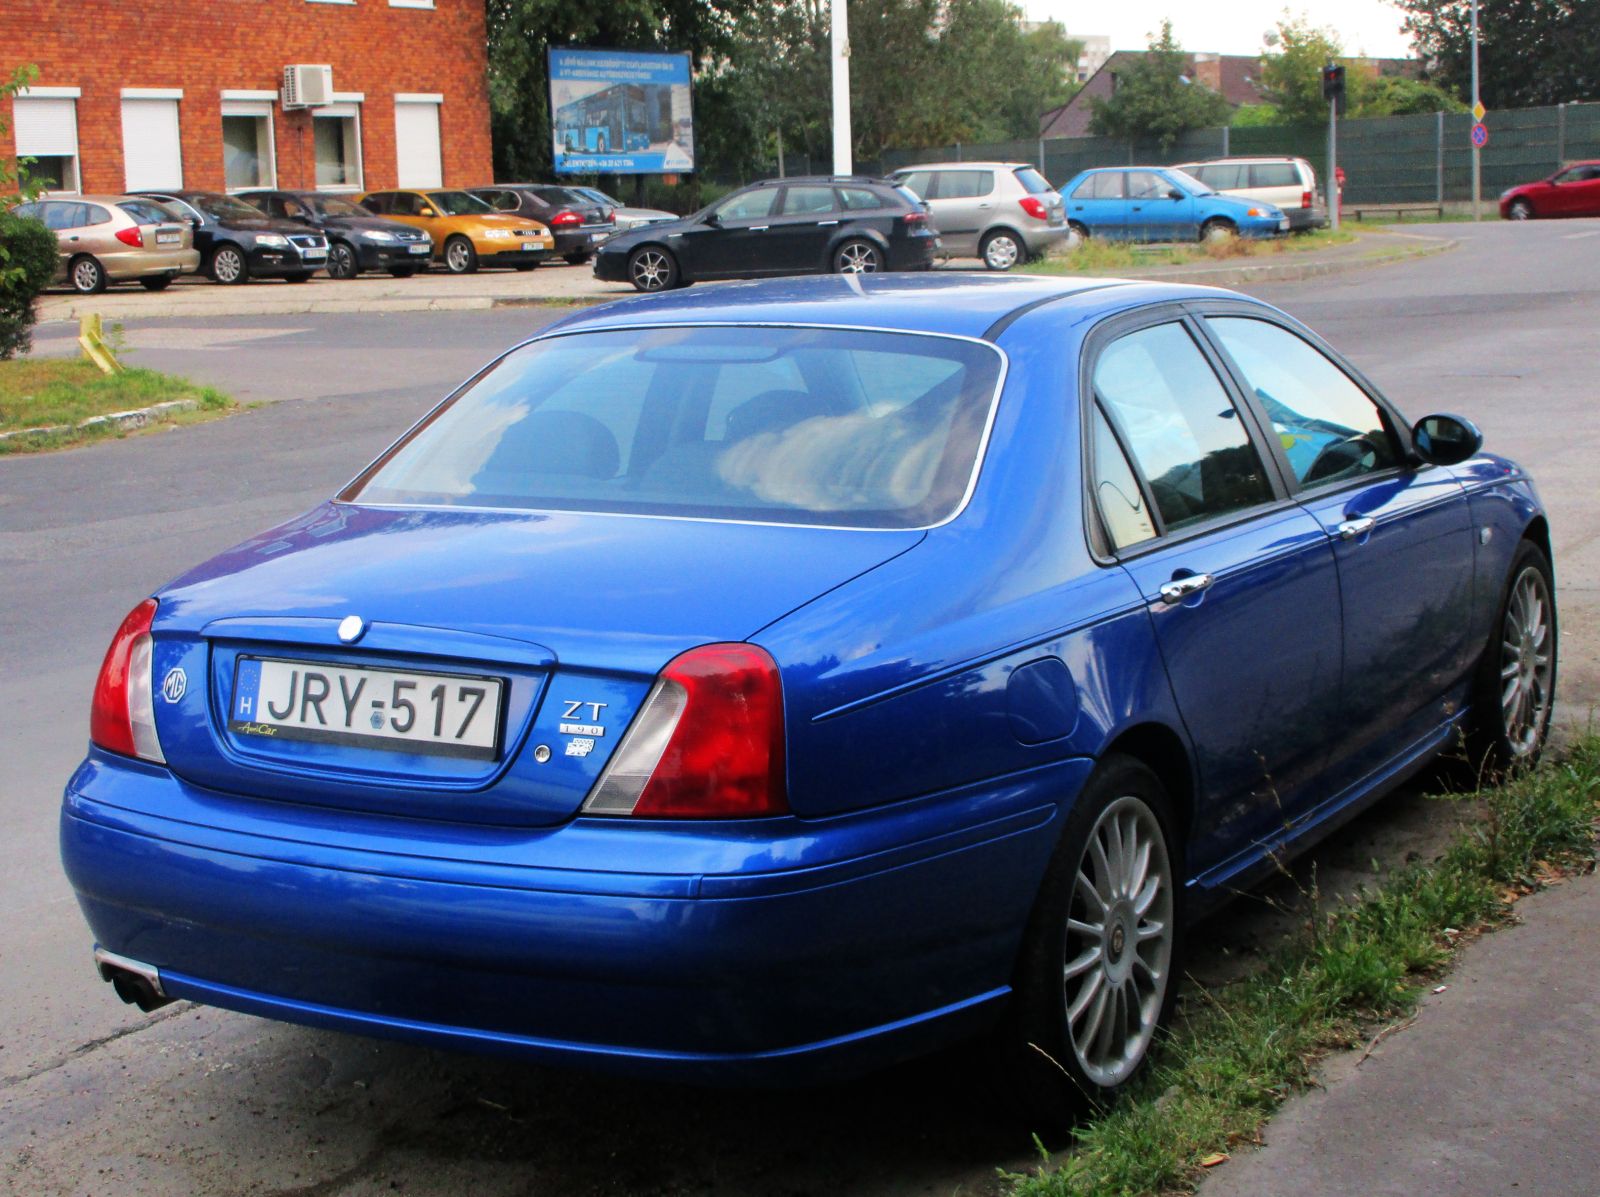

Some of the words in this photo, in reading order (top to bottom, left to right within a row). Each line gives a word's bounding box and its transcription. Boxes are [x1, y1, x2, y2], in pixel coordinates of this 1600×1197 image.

[165, 671, 184, 699] MG
[240, 696, 253, 715] H
[268, 670, 486, 739] JRY-517
[561, 700, 608, 721] ZT
[563, 725, 600, 735] 190
